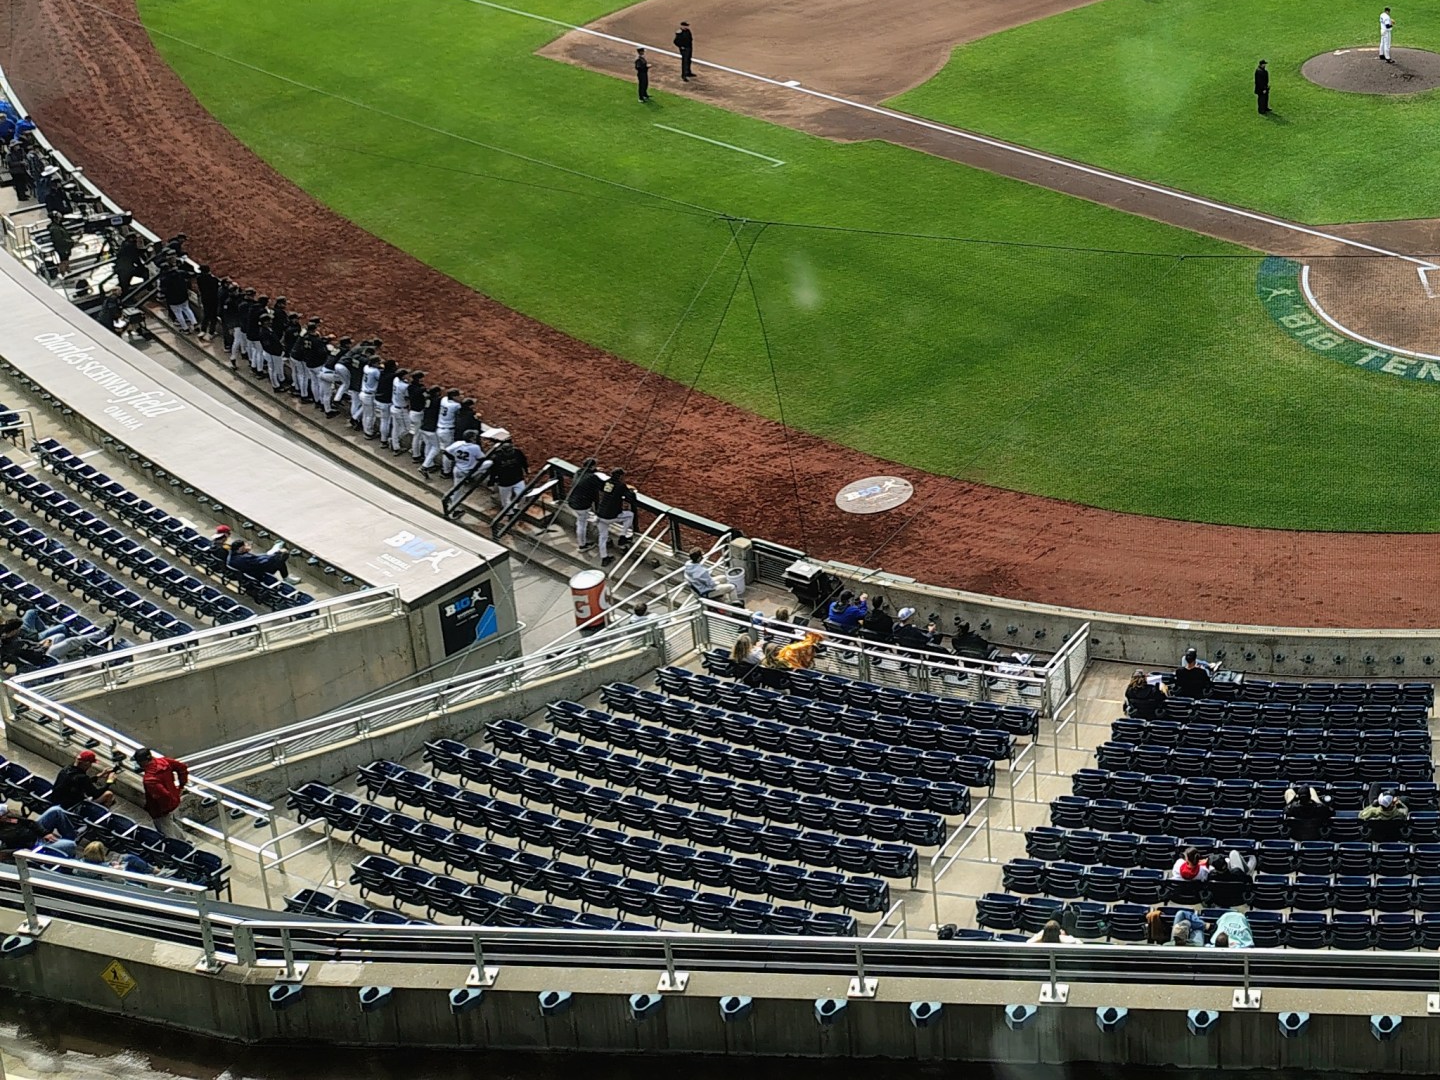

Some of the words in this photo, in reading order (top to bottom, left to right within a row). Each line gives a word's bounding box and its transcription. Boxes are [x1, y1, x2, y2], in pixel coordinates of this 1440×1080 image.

[1279, 311, 1345, 351] BIG
[34, 332, 96, 370] charles
[106, 388, 185, 417] field
[104, 406, 143, 431] OMAHA
[456, 449, 470, 462] 22
[573, 594, 591, 618] G
